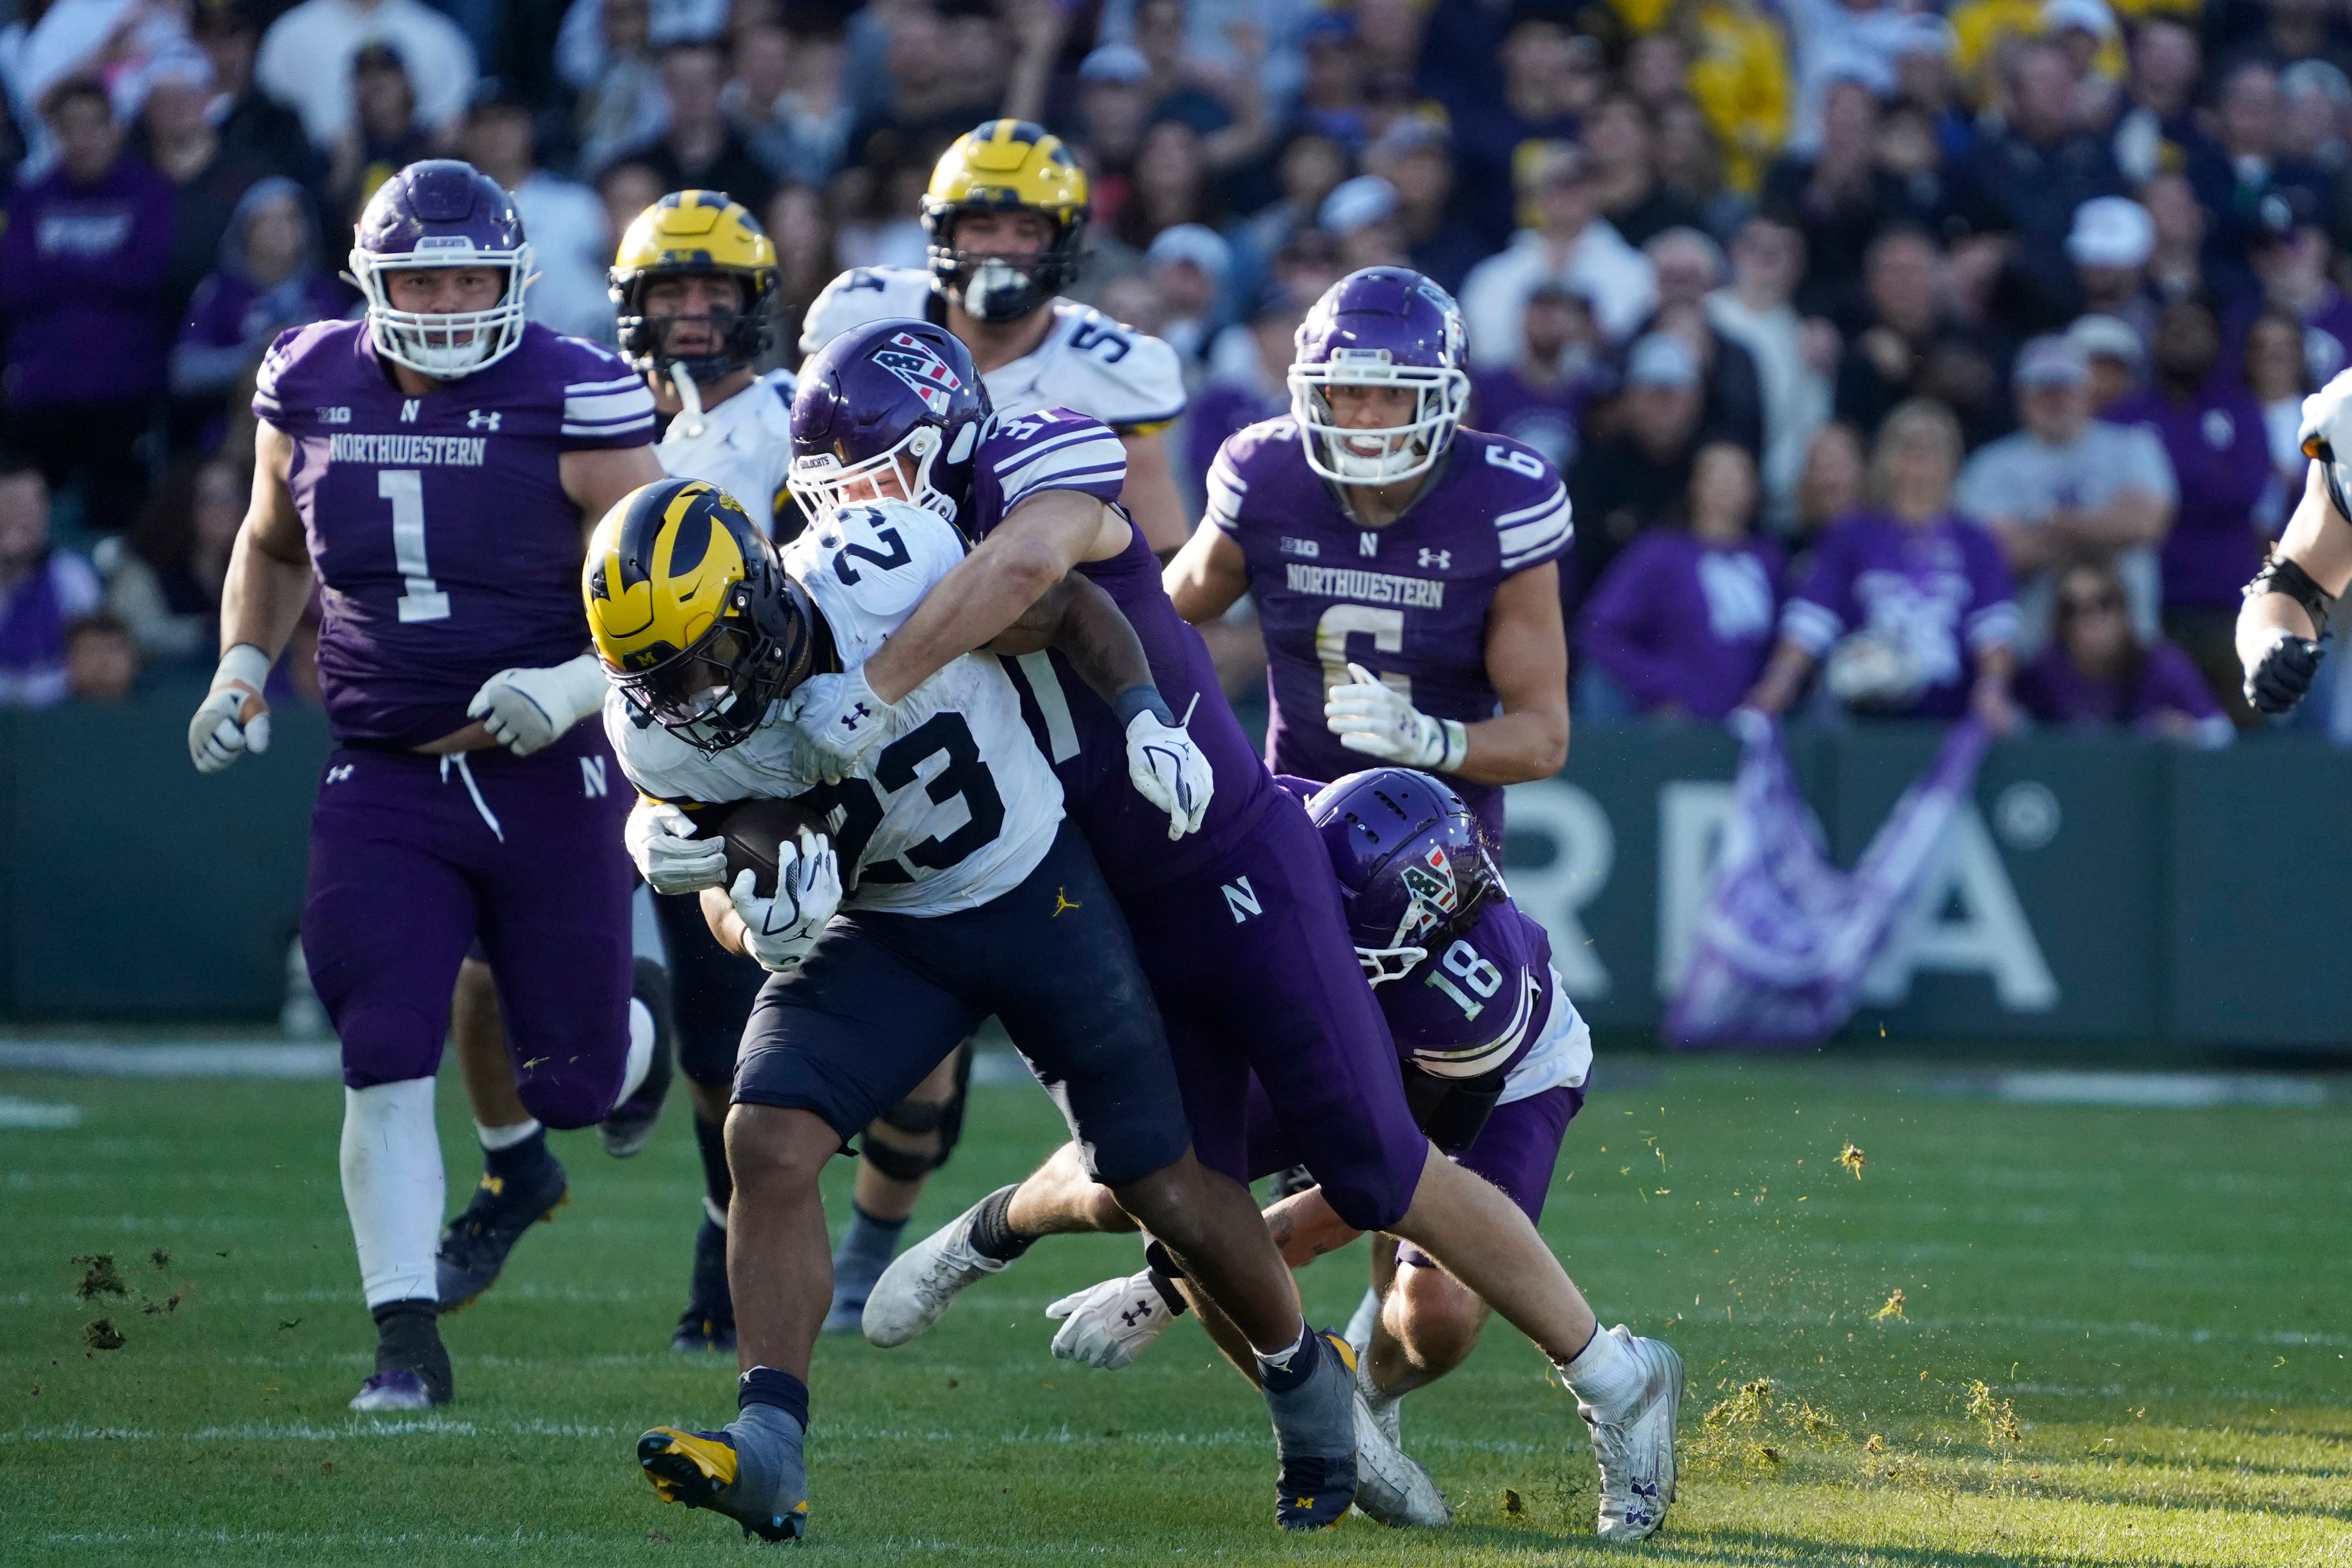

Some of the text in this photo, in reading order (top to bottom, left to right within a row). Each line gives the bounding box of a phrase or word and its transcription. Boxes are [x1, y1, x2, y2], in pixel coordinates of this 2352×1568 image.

[400, 399, 420, 423] N
[330, 433, 486, 467] NORTHWESTERN
[800, 456, 829, 469] WILDCATS
[1485, 444, 1545, 480] 6
[378, 469, 451, 623] 1
[1359, 531, 1378, 557] N
[1286, 563, 1445, 609] NORTHWESTERN
[636, 651, 657, 666] M
[580, 755, 608, 797] N
[812, 711, 1006, 884] 23
[1220, 875, 1263, 923] N
[1424, 939, 1503, 1022] 18
[1295, 1497, 1314, 1509] M
